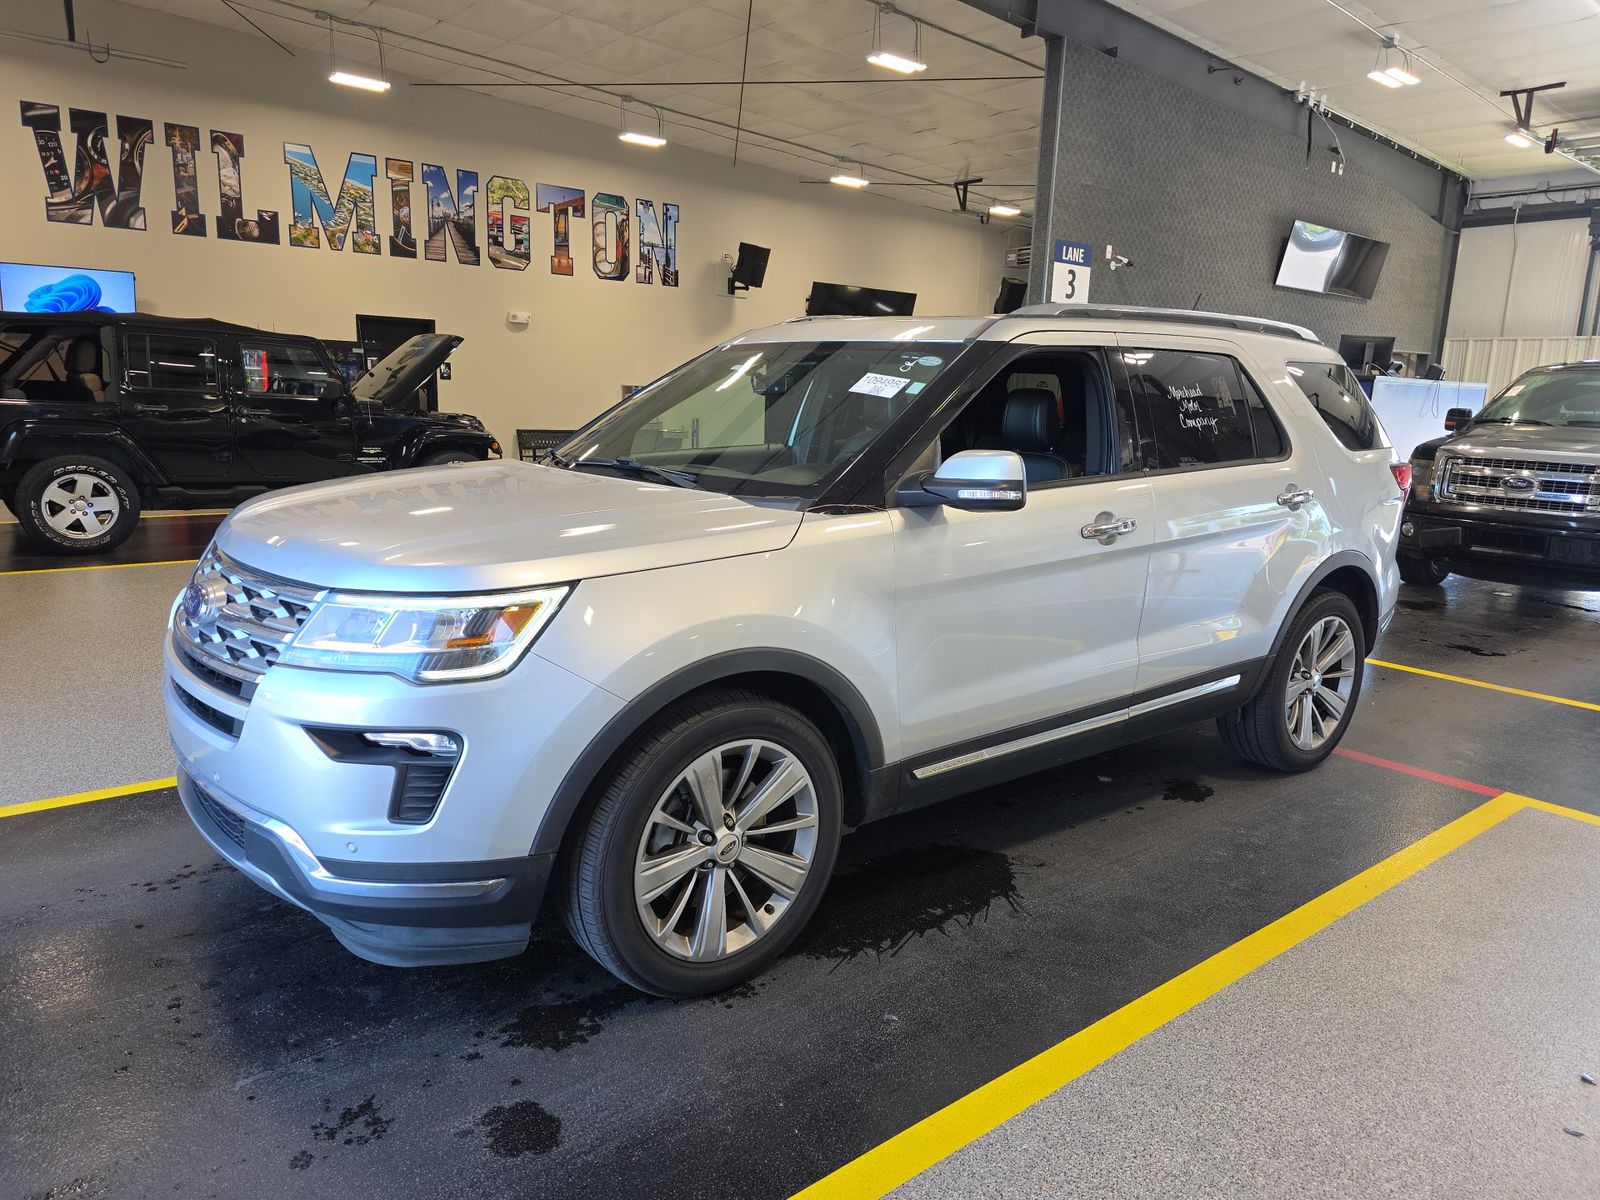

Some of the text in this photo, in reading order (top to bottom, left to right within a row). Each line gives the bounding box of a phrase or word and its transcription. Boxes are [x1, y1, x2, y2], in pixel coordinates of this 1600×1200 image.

[20, 100, 680, 287] WILMINGTON
[1062, 245, 1085, 263] LANE
[1065, 268, 1077, 300] 3
[1180, 414, 1218, 434] Company
